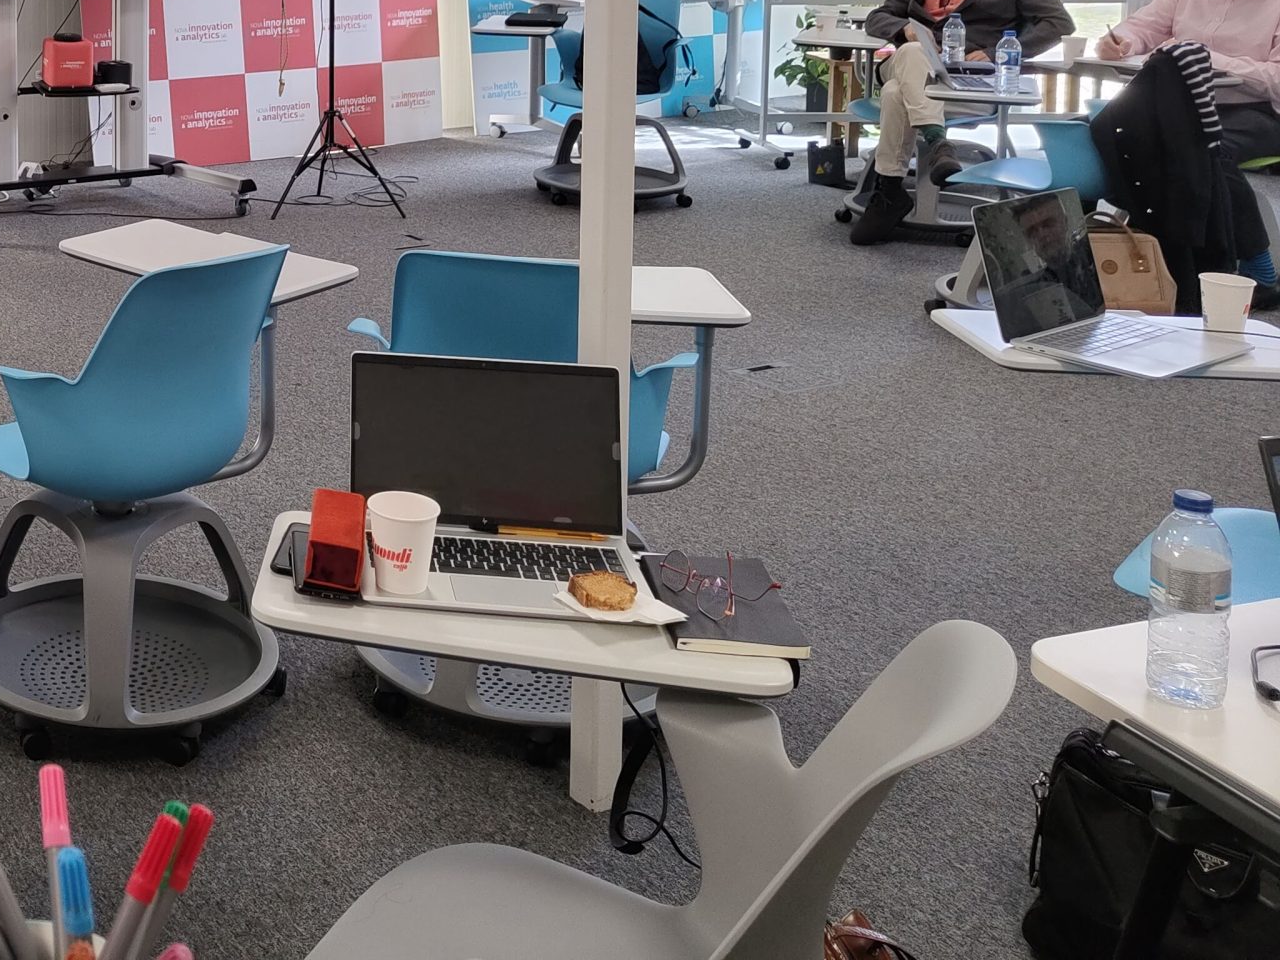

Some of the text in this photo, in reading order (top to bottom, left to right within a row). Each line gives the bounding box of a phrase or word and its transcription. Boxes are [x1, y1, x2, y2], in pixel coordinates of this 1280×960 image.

[398, 8, 432, 17] innovation
[264, 16, 306, 26] innovation
[392, 18, 422, 28] analytics
[188, 22, 233, 32] innovation
[180, 32, 220, 42] analytics
[256, 27, 293, 38] analytics
[494, 80, 518, 90] health
[402, 89, 436, 98] innovation
[488, 90, 520, 99] analytics
[338, 94, 376, 104] innovation
[395, 99, 426, 109] analytics
[269, 102, 310, 112] innovation
[194, 108, 239, 119] innovation
[262, 112, 298, 122] analytics
[187, 119, 226, 130] analytics
[372, 539, 412, 564] uondi
